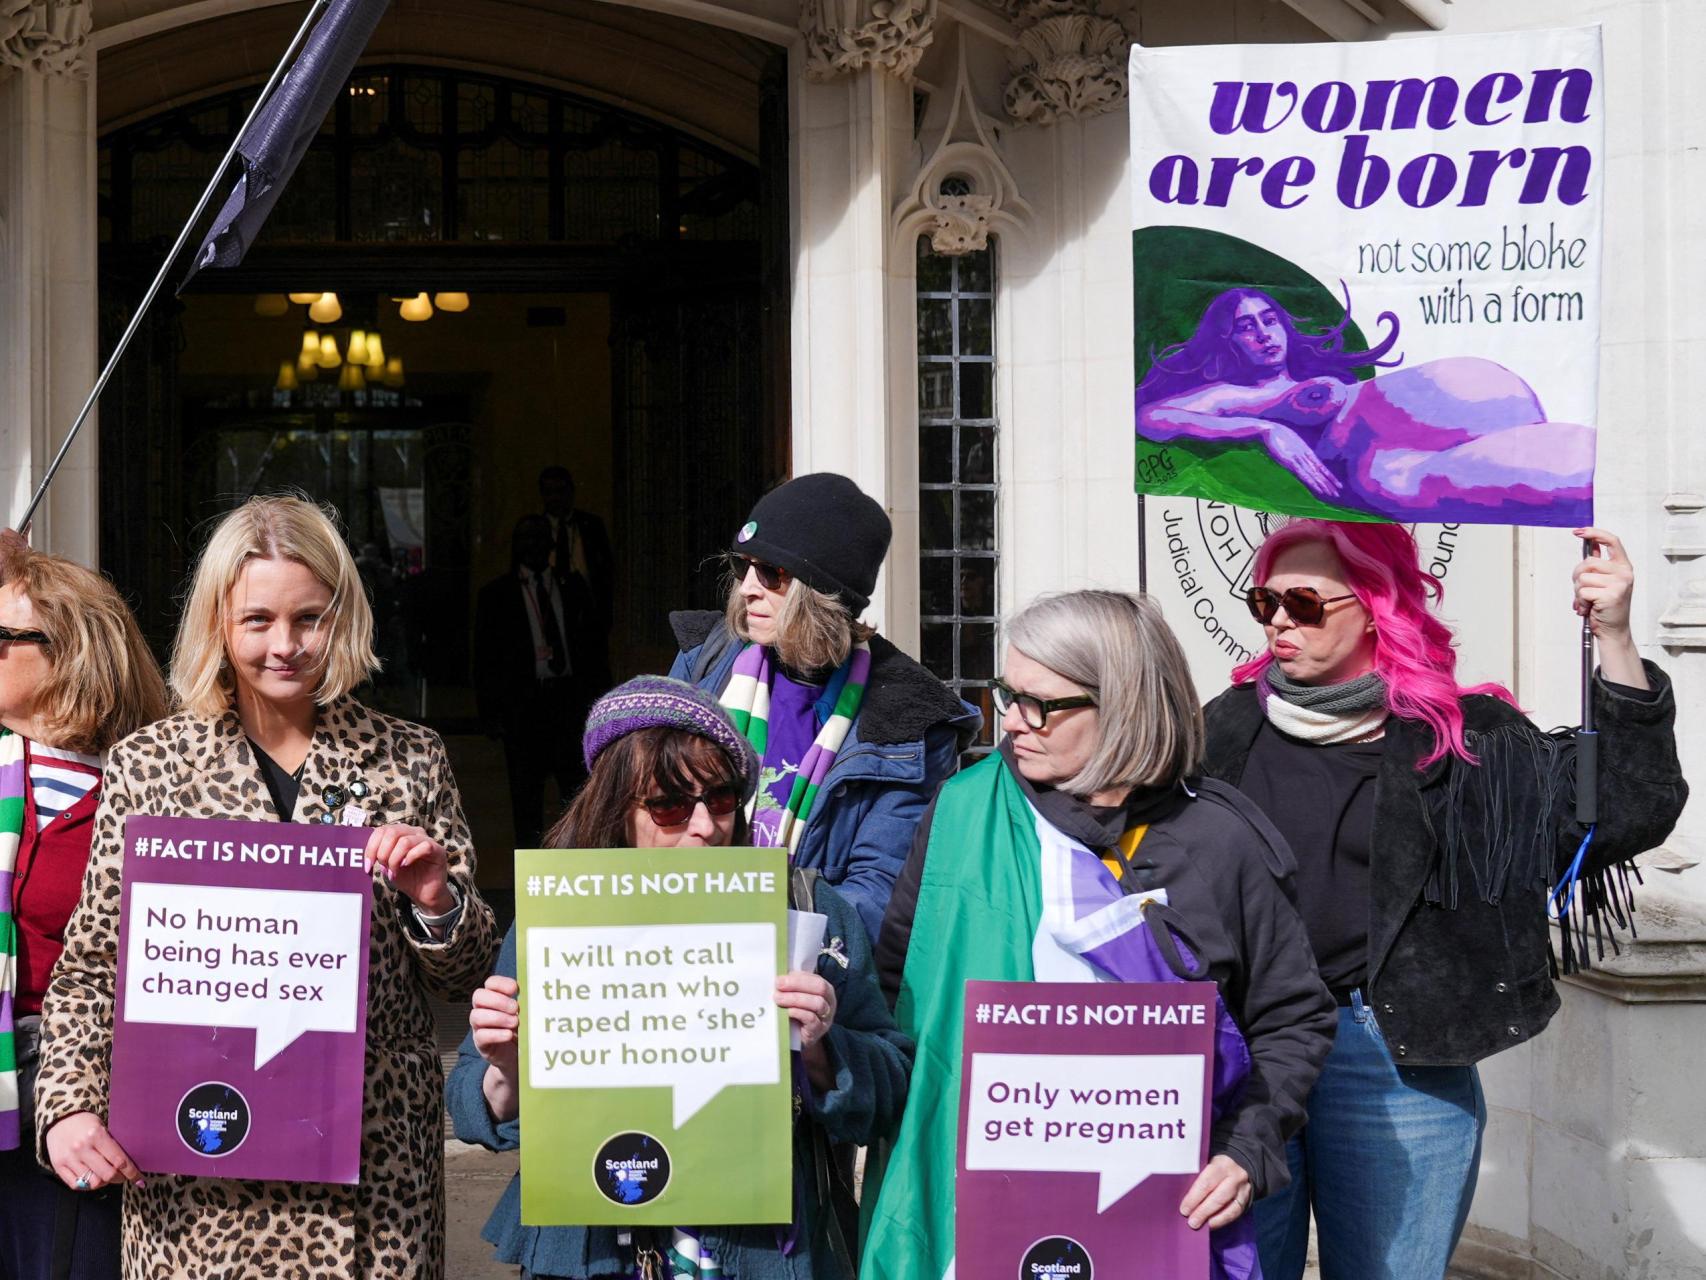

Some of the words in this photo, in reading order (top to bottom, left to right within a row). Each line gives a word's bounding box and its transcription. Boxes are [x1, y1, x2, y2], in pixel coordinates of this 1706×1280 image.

[1209, 68, 1593, 134] women
[1149, 155, 1315, 209] are
[1337, 135, 1591, 209] born
[1358, 240, 1405, 273] not
[1411, 241, 1492, 273] some
[1502, 222, 1586, 270] bloke
[1419, 278, 1473, 324] with
[1484, 293, 1501, 323] a
[1512, 286, 1583, 322] form
[1163, 509, 1204, 598] Judicial
[134, 837, 208, 860] #FACT
[212, 841, 234, 862] IS
[240, 842, 294, 865] NOT
[299, 845, 365, 869] HATE
[526, 874, 605, 897] #FACT
[611, 873, 634, 896] IS
[640, 872, 699, 895] NOT
[704, 871, 775, 893] HATE
[147, 907, 187, 930] No
[196, 908, 299, 936] human
[144, 938, 221, 970] being
[231, 943, 279, 967] has
[288, 952, 348, 970] ever
[543, 946, 550, 968] I
[560, 944, 615, 968] will
[625, 945, 673, 967] not
[683, 941, 735, 965] call
[142, 971, 268, 1003] changed
[279, 984, 323, 1002] sex
[542, 978, 591, 1001] the
[601, 982, 667, 1000] man
[676, 975, 740, 998] who
[544, 1009, 630, 1039] raped
[641, 1014, 687, 1032] me
[975, 1003, 1051, 1025] #FACT
[1056, 1004, 1078, 1026] IS
[1083, 1004, 1138, 1026] NOT
[1142, 1004, 1206, 1025] HATE
[543, 1049, 612, 1071] your
[621, 1042, 731, 1065] honour
[987, 1081, 1060, 1110] Only
[1069, 1088, 1179, 1106] women
[188, 1108, 238, 1120] Scotland
[984, 1117, 1034, 1142] get
[1044, 1118, 1186, 1144] pregnant
[605, 1158, 659, 1170] Scotland
[1031, 1263, 1081, 1274] Scotland
